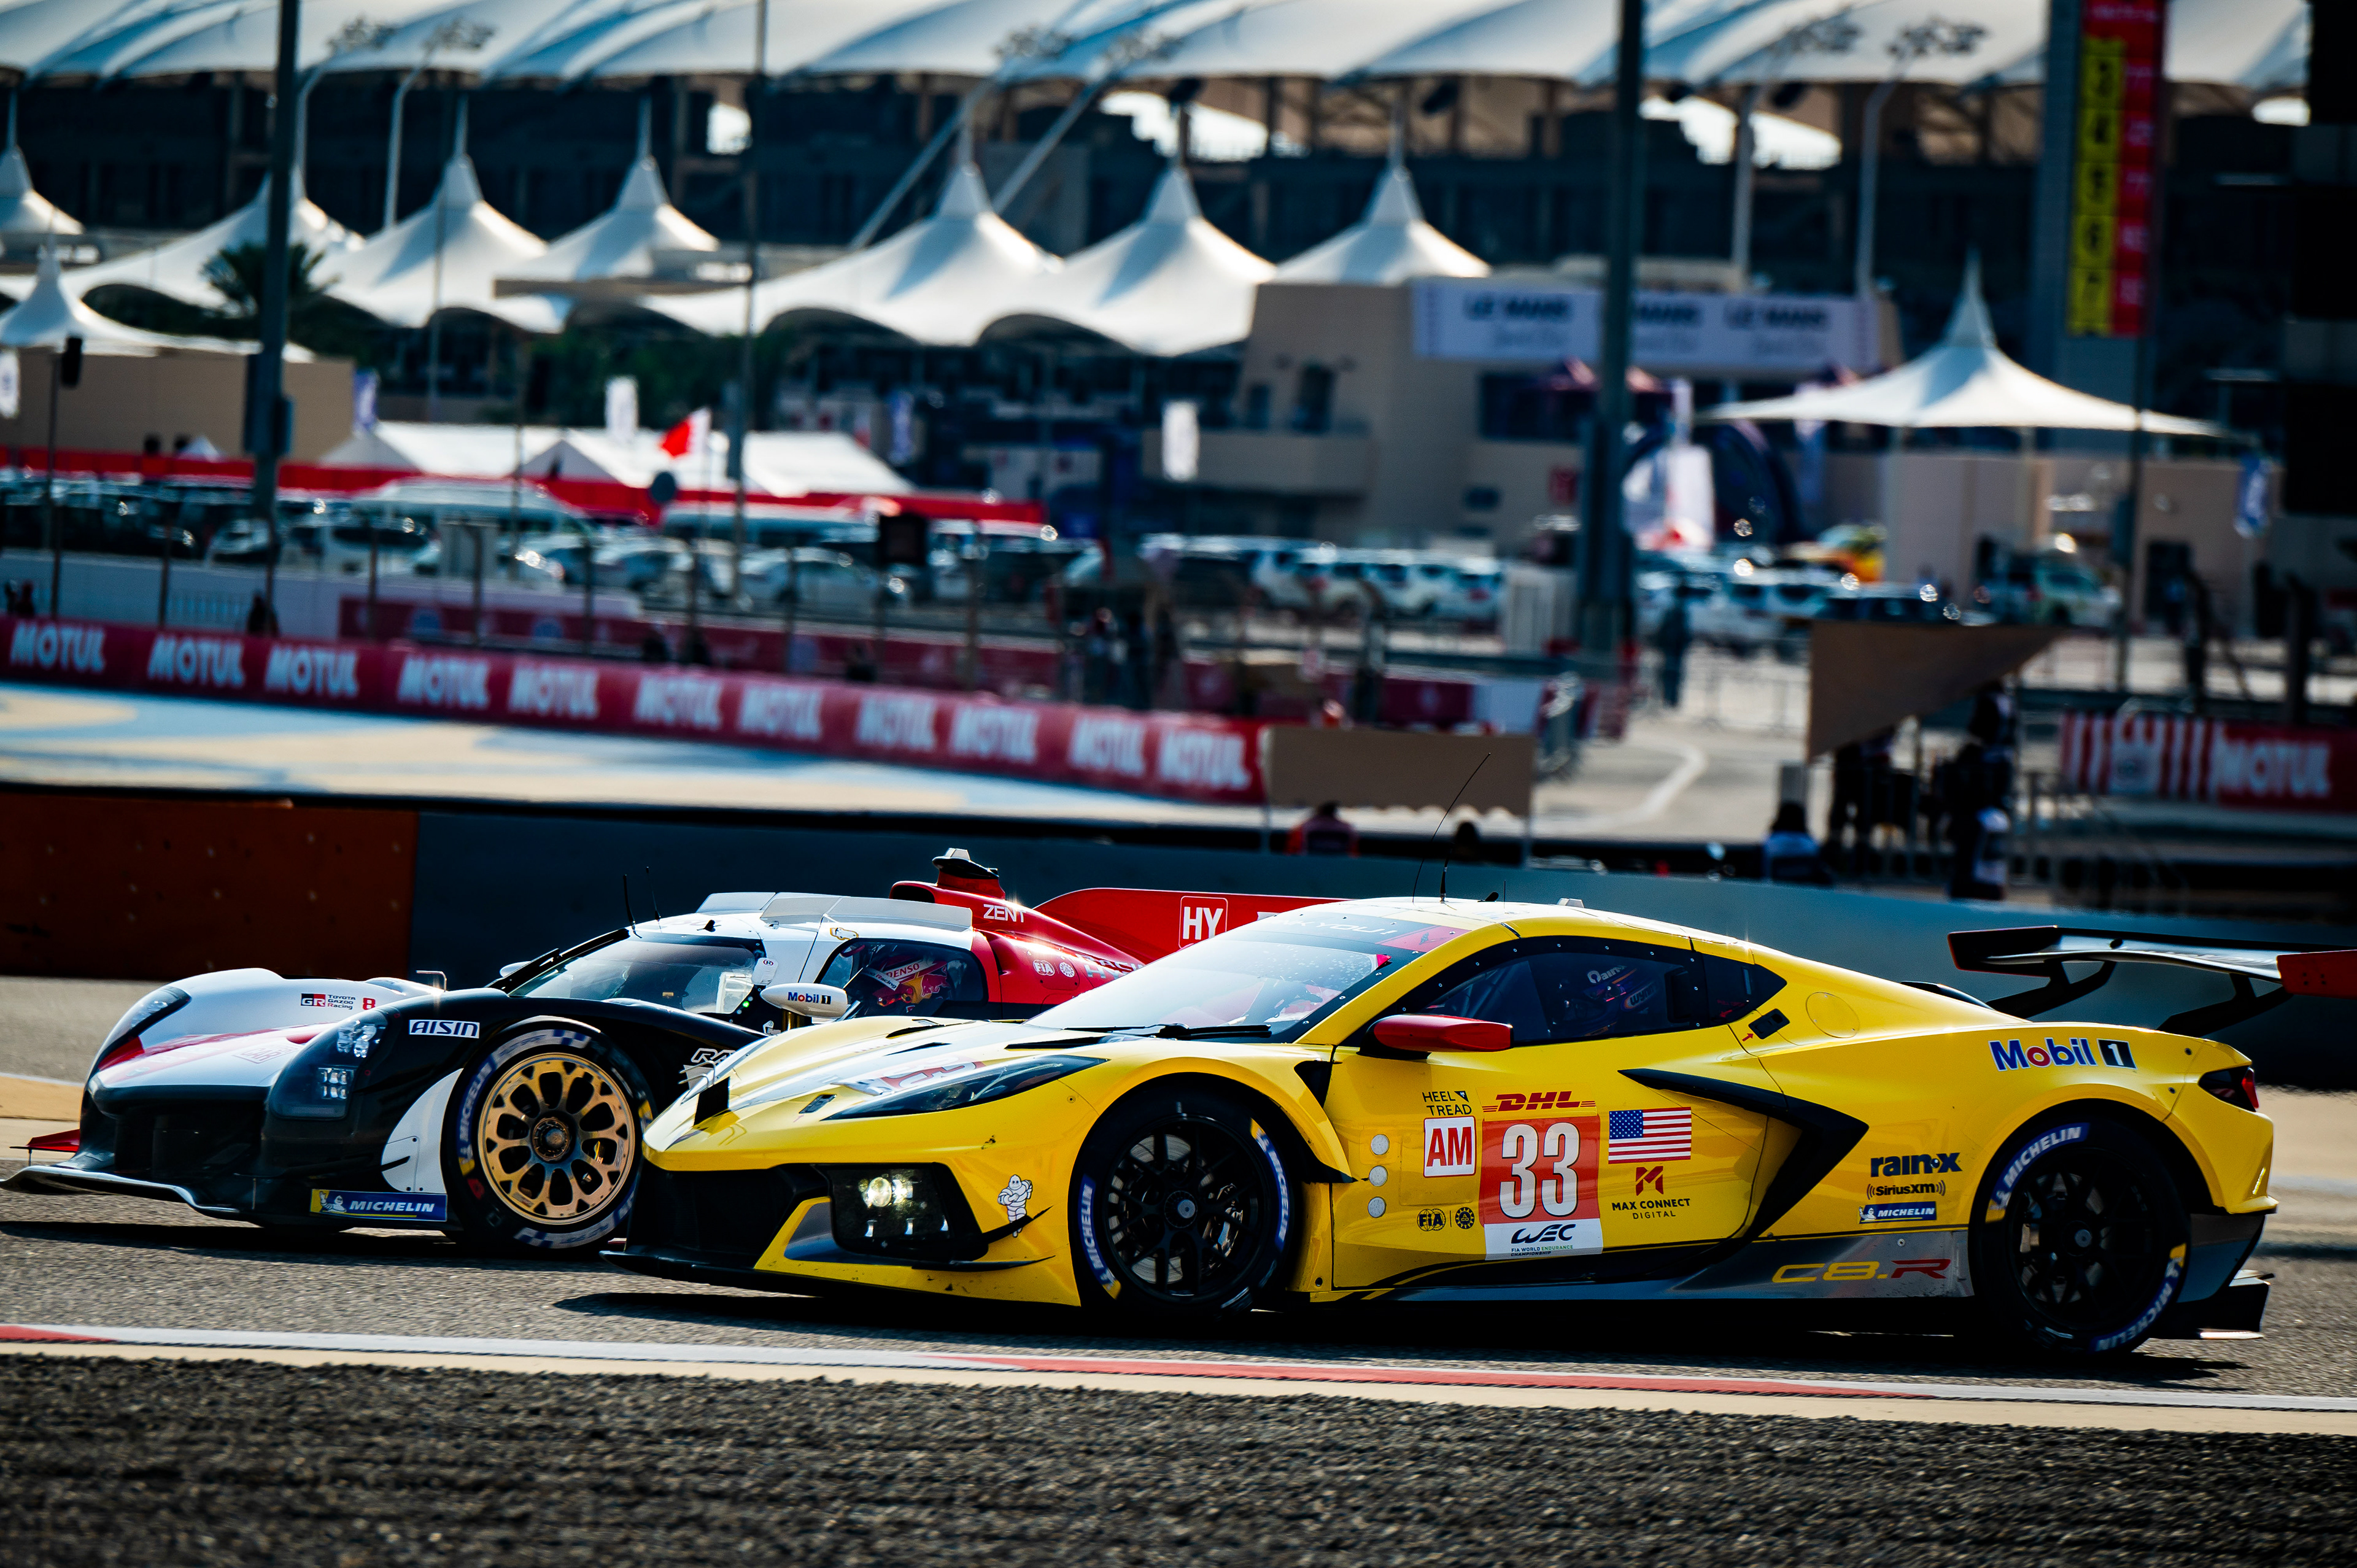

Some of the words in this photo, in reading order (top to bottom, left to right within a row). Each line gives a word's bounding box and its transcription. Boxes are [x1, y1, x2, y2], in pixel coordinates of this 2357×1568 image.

[10, 620, 106, 673] MOTUL
[148, 634, 245, 688] MOTUL
[265, 644, 360, 698] MOTUL
[397, 655, 489, 709] MOTUL
[983, 904, 1026, 922] ZENT
[1182, 906, 1224, 940] HY
[886, 963, 920, 978] DENSO
[876, 973, 897, 989] Racing
[301, 998, 325, 1006] GR
[363, 997, 376, 1010] 8
[788, 992, 819, 1003] Mobil
[411, 1021, 478, 1037] AISIN
[1988, 1037, 2098, 1072] Mobil
[1422, 1091, 1455, 1102] HEEL
[1496, 1091, 1581, 1112] DHL
[1426, 1104, 1472, 1116] TREAD
[1426, 1127, 1472, 1167] AM
[2003, 1126, 2082, 1188] MICHELIN
[1500, 1122, 1581, 1219] 33
[349, 1200, 435, 1212] MICHELIN
[1612, 1201, 1637, 1211] MAX
[1639, 1198, 1690, 1209] CONNECT
[1633, 1210, 1676, 1219] DIGITAL
[1878, 1208, 1935, 1217] MICHELIN
[1082, 1184, 1104, 1269] MICHELIN
[1511, 1224, 1576, 1244] WEC
[1771, 1259, 1951, 1283] C8.R
